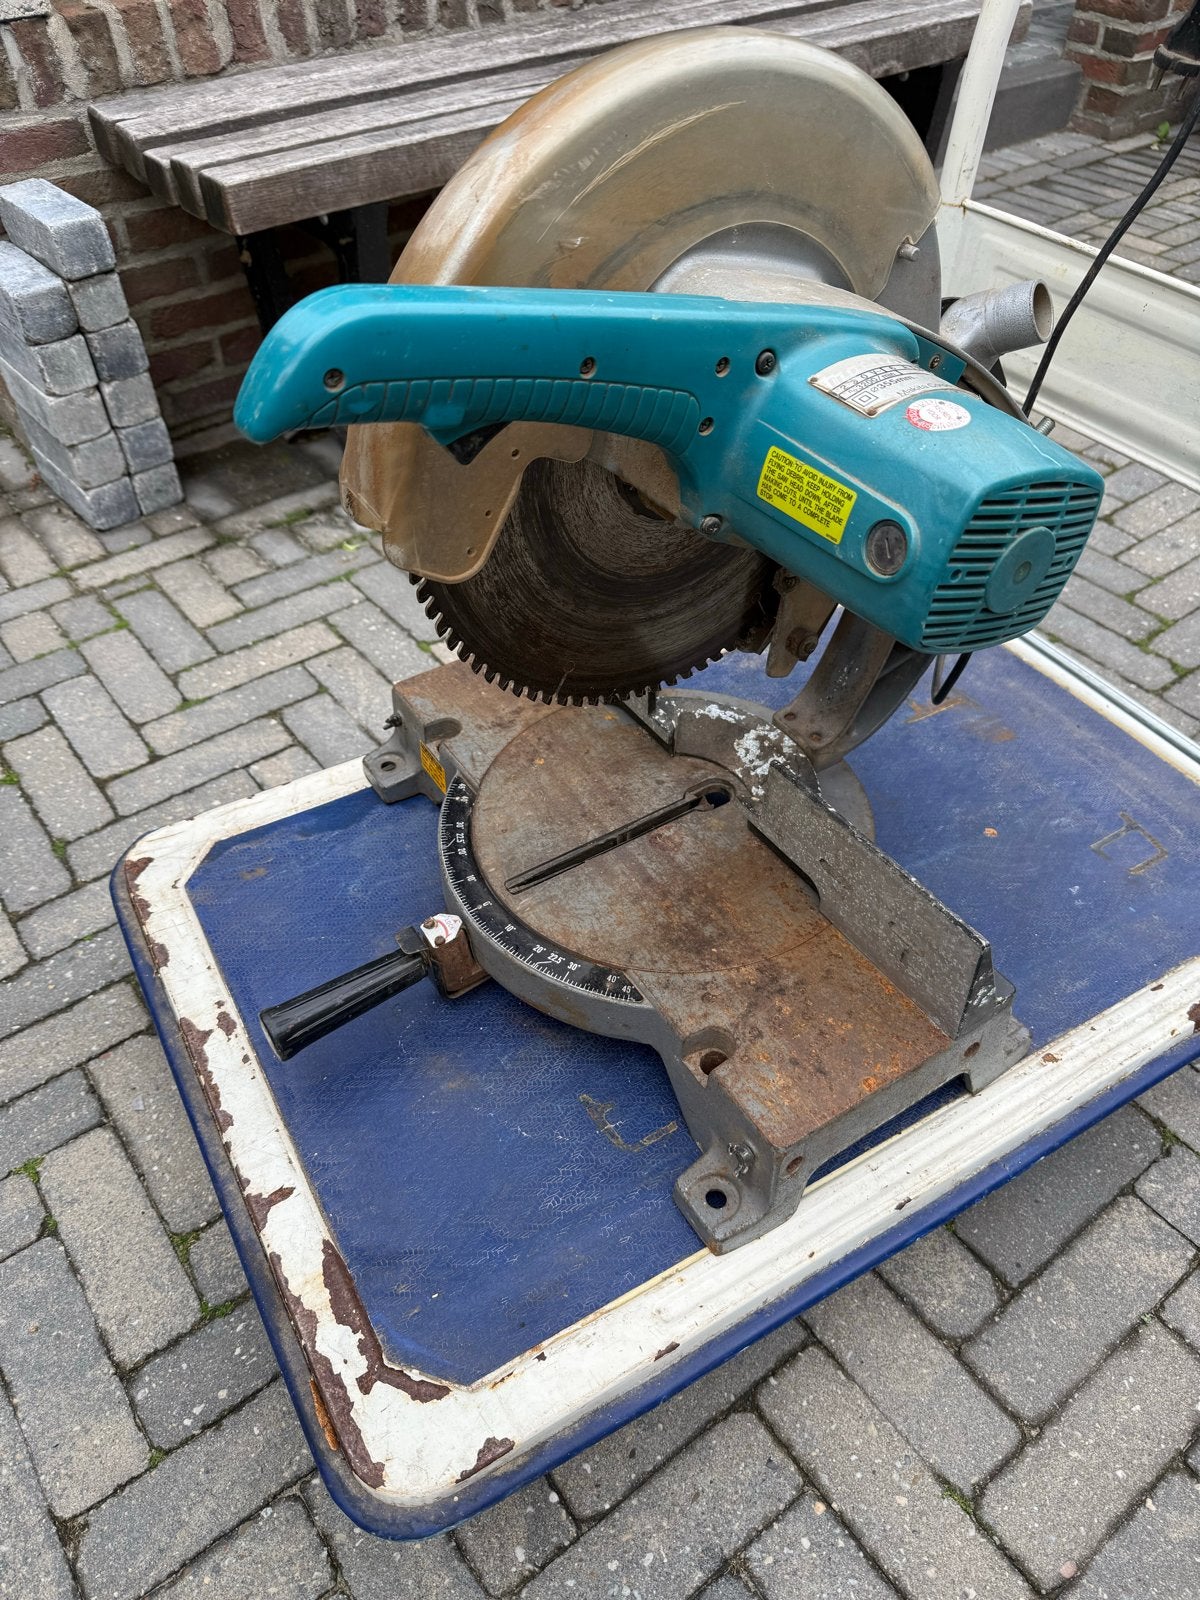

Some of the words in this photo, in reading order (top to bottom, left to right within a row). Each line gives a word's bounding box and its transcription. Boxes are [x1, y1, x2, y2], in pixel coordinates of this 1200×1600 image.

[768, 458, 785, 473] FLYING
[807, 480, 821, 492] KEEP
[822, 489, 845, 507] HOLDING
[794, 461, 802, 472] TO
[802, 467, 818, 481] AVOID
[818, 475, 836, 493] INJURY
[837, 487, 853, 501] FROM
[760, 489, 774, 502] STOP.
[766, 467, 776, 476] THE
[777, 472, 788, 485] SAW
[790, 480, 804, 493] HEAD
[823, 500, 841, 514] AFTER
[762, 482, 772, 494] HAS
[773, 488, 787, 502] COME
[789, 498, 797, 507] TO
[803, 507, 831, 528] COMPLETE
[764, 474, 782, 490] MAKING
[799, 494, 813, 508] UNTIL
[814, 504, 825, 515] THE
[825, 509, 843, 525] BLADE
[505, 924, 517, 932] 10°
[532, 944, 546, 954] 20°
[548, 952, 565, 964] 22.5°
[567, 962, 581, 970] 30°
[607, 975, 620, 983] 40°
[622, 985, 634, 993] 45°
